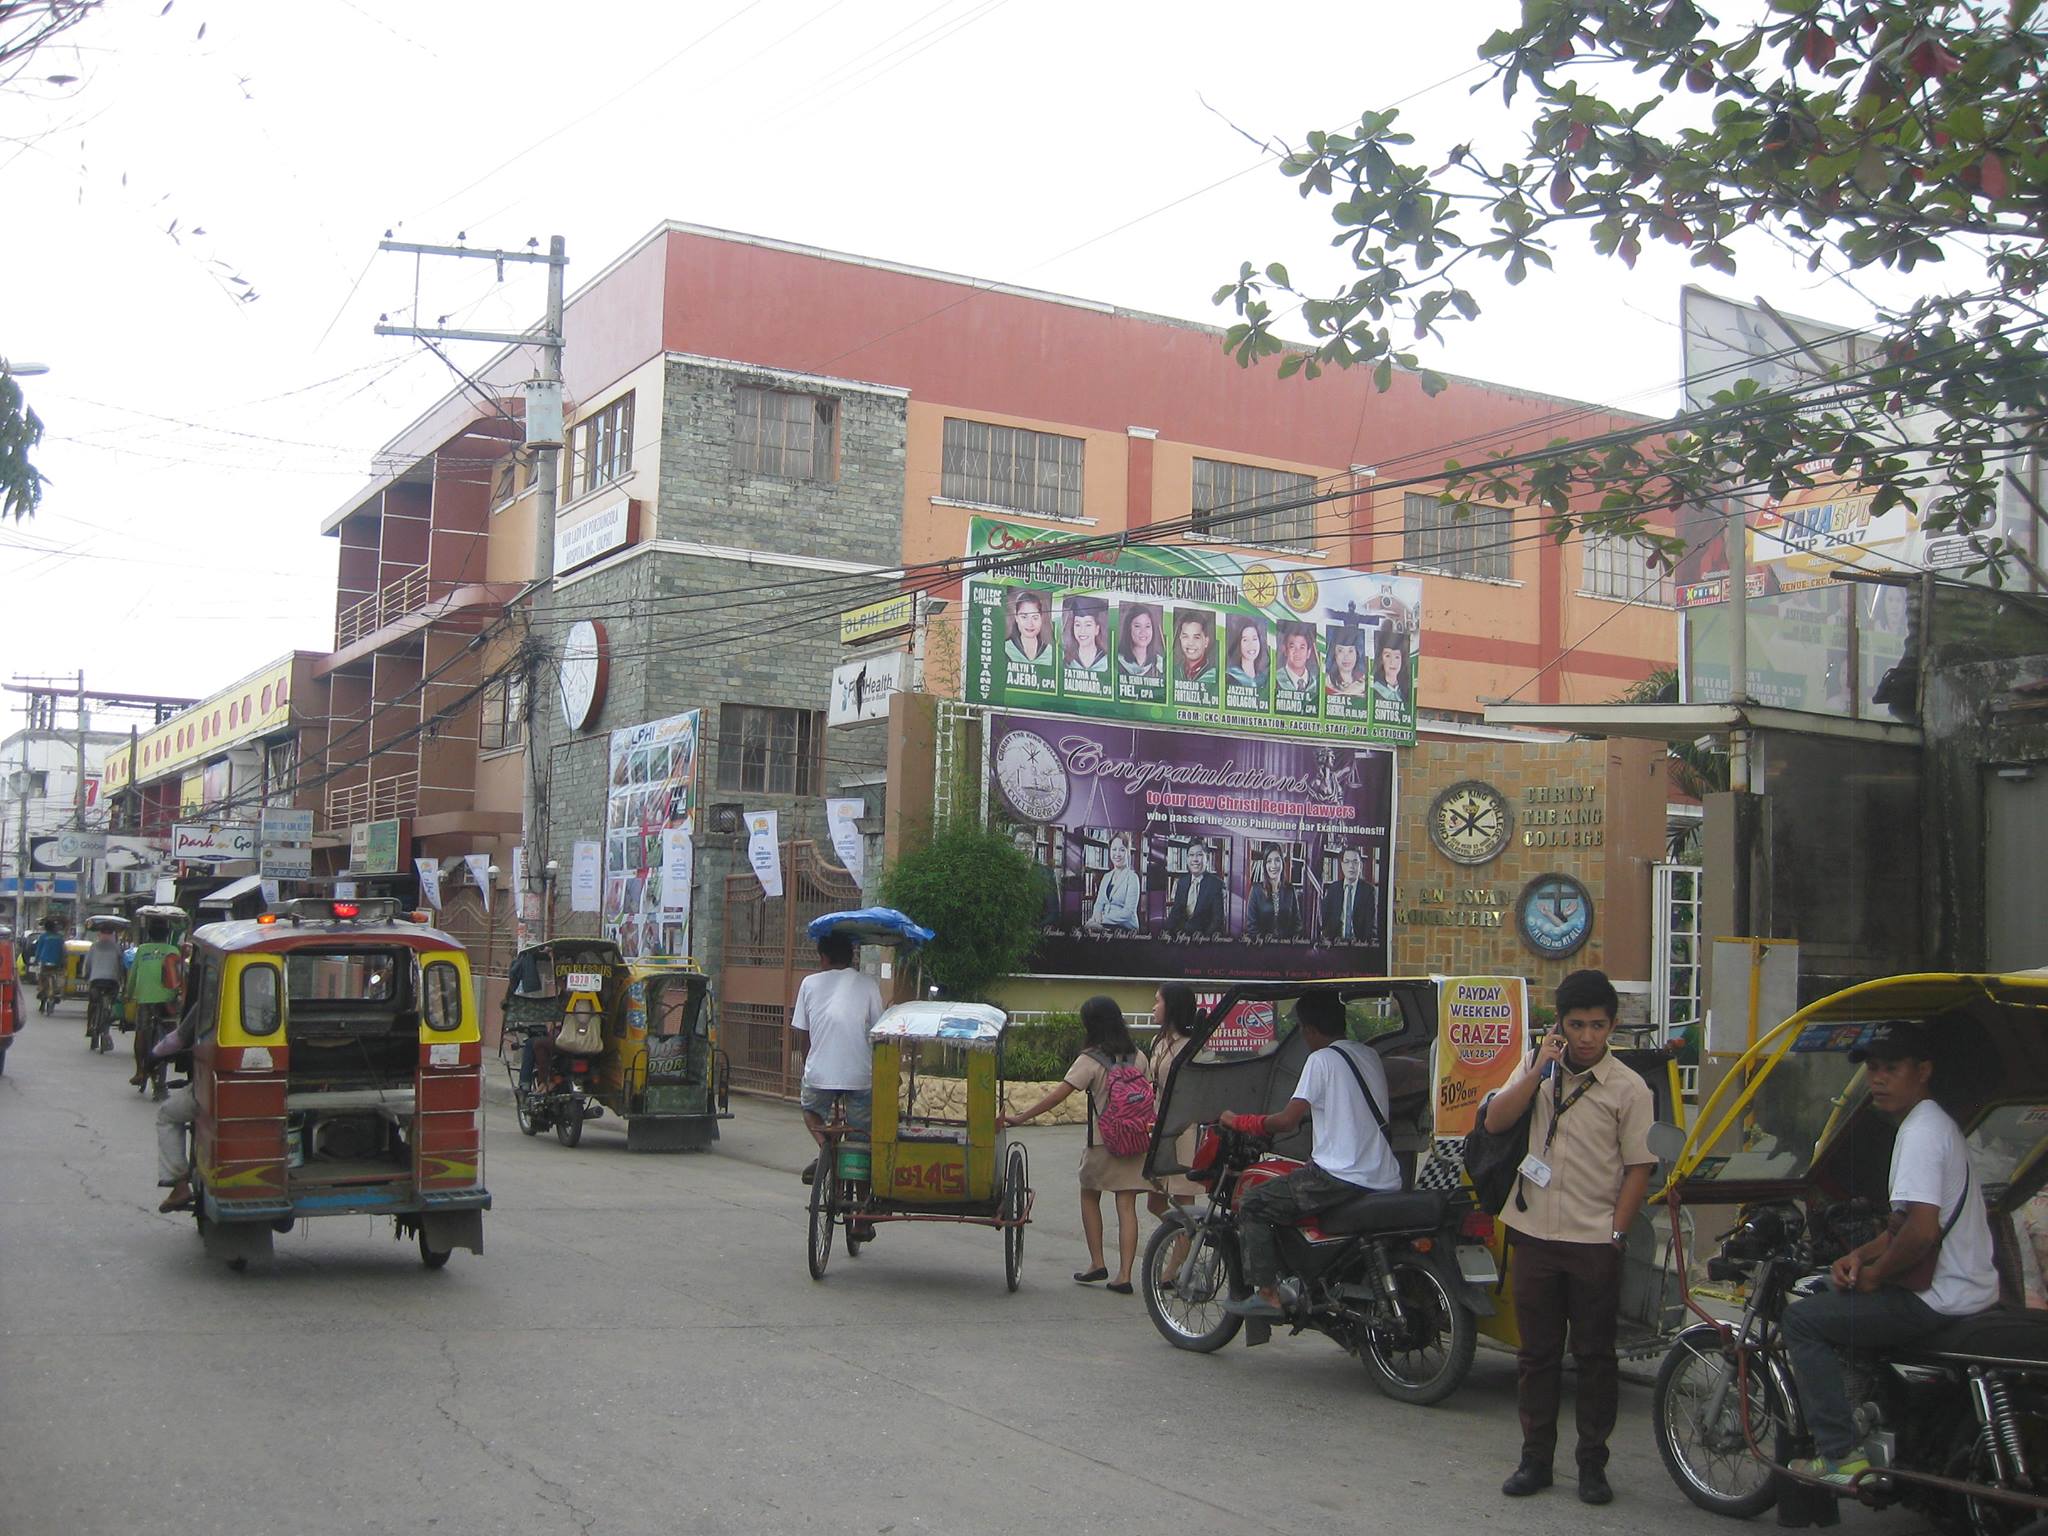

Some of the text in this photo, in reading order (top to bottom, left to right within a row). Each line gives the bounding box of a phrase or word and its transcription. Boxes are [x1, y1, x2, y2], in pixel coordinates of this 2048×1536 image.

[1782, 529, 1866, 555] CUP 2017
[1034, 561, 1051, 581] the
[1052, 562, 1077, 586] May
[1077, 566, 1102, 588] 2017
[1125, 572, 1174, 597] LICENSURE
[1175, 578, 1239, 605] EXAMINATION
[882, 602, 905, 623] EXIT
[980, 618, 993, 700] ACCOUNTANCY
[1006, 671, 1056, 689] AJERO, CPA
[1175, 680, 1199, 691] ROGELIO
[1120, 684, 1154, 700] FIEL, CPA
[1276, 690, 1293, 699] JOHN
[1260, 701, 1268, 710] CPA
[1305, 705, 1316, 714] CPA
[1177, 710, 1201, 721] FROM:
[1204, 713, 1219, 723] CKC
[1402, 714, 1412, 723] CPA
[1058, 735, 1308, 795] Congratulations
[1448, 789, 1489, 804] THE KING
[1527, 786, 1596, 804] CHRIST
[1146, 790, 1161, 806] to
[1162, 795, 1186, 808] our
[1187, 796, 1216, 810] new
[1217, 794, 1260, 812] Christi
[1306, 801, 1355, 820] Lawyers
[1146, 812, 1385, 836] who passed the 2016 Philippine Bar Examinations!!!
[1438, 799, 1504, 841] CHRIST COLLEGE
[1522, 808, 1603, 827] THE KING
[178, 834, 215, 850] Park
[234, 835, 251, 852] Go
[1522, 830, 1604, 848] COLLEGE
[1458, 986, 1501, 1000] PAYDAY
[1450, 1004, 1512, 1018] WEEKEND
[1450, 1023, 1511, 1045] CRAZE
[1459, 1050, 1496, 1059] JULY 28-31
[1440, 1079, 1477, 1106] 50% OFF
